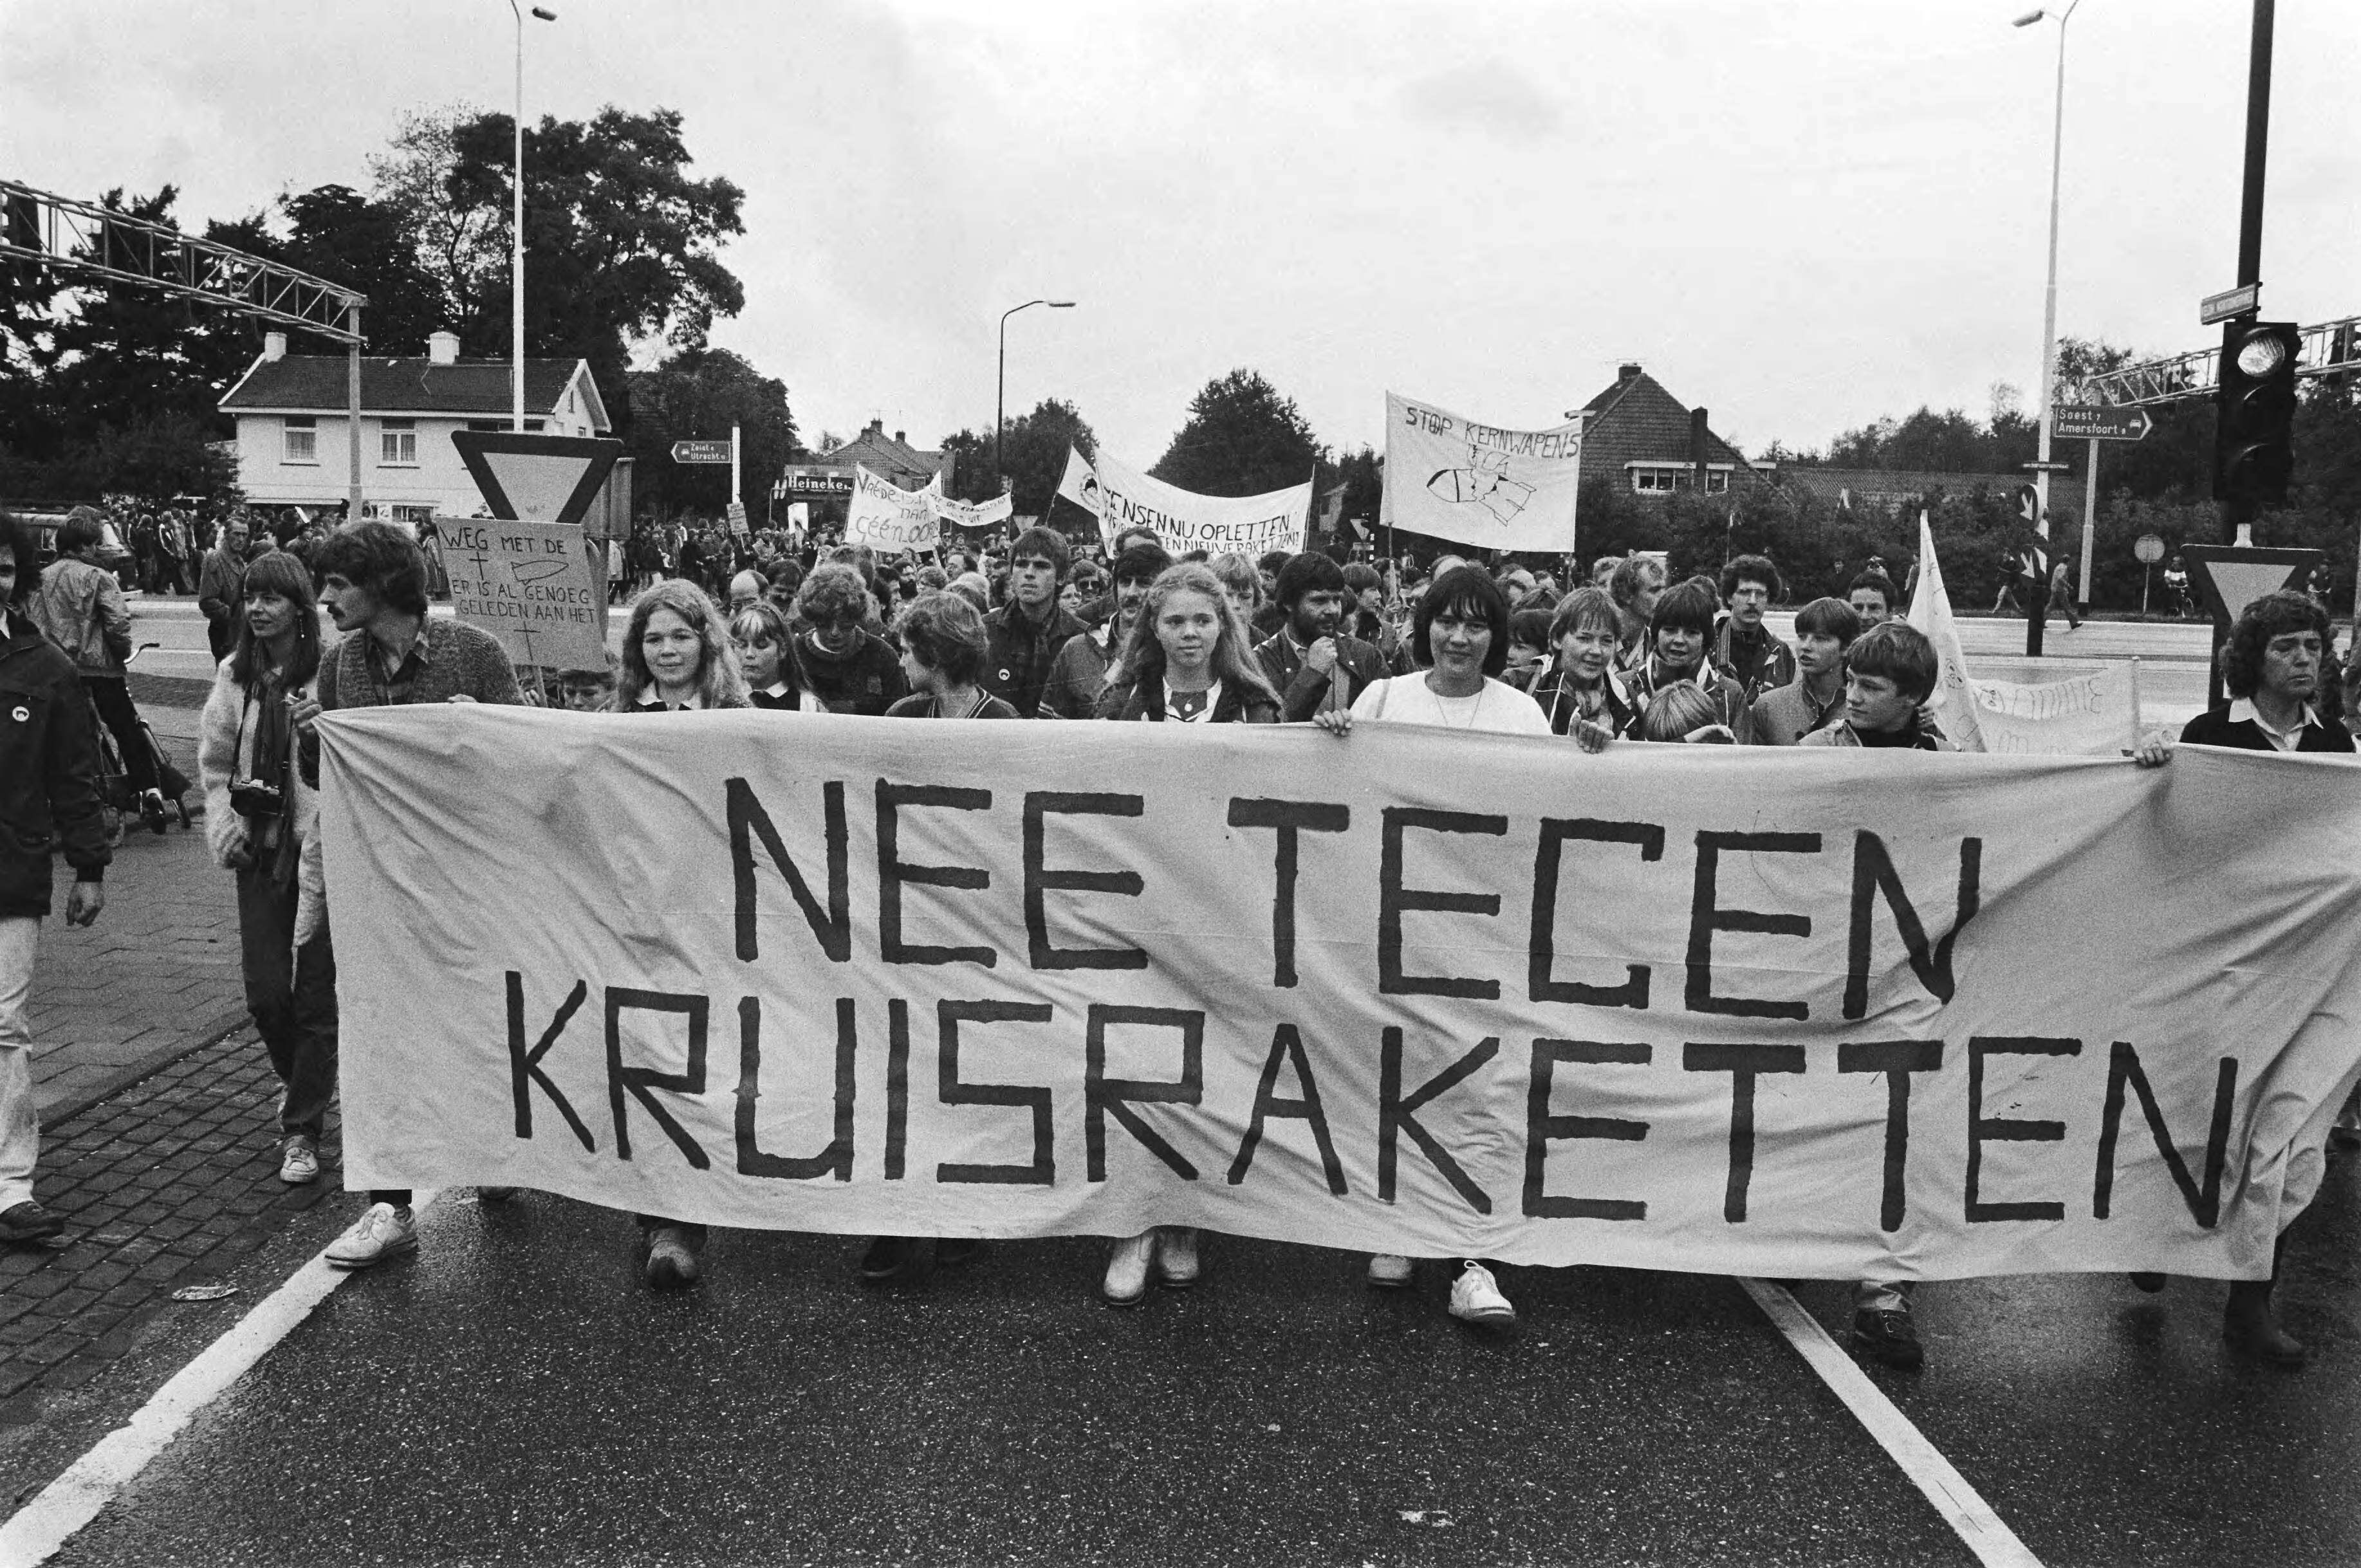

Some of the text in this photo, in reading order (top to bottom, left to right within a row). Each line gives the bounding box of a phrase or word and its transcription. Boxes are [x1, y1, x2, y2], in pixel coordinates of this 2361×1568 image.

[2058, 421, 2118, 434] Amersfoort
[2059, 409, 2092, 421] Soest
[1405, 406, 1581, 459] STOP KERNWAPENS
[788, 476, 852, 490] Heineke
[439, 526, 568, 555] WEG MET DE
[1170, 517, 1196, 539] NU
[1200, 515, 1290, 541] OPLETTEN
[451, 580, 589, 604] ER IS AL GENOEG
[459, 599, 595, 623] GELEDEN AAN HET
[725, 777, 1983, 1020] NEE TEGEN
[505, 970, 2239, 1231] KRUISRAKETTEN
